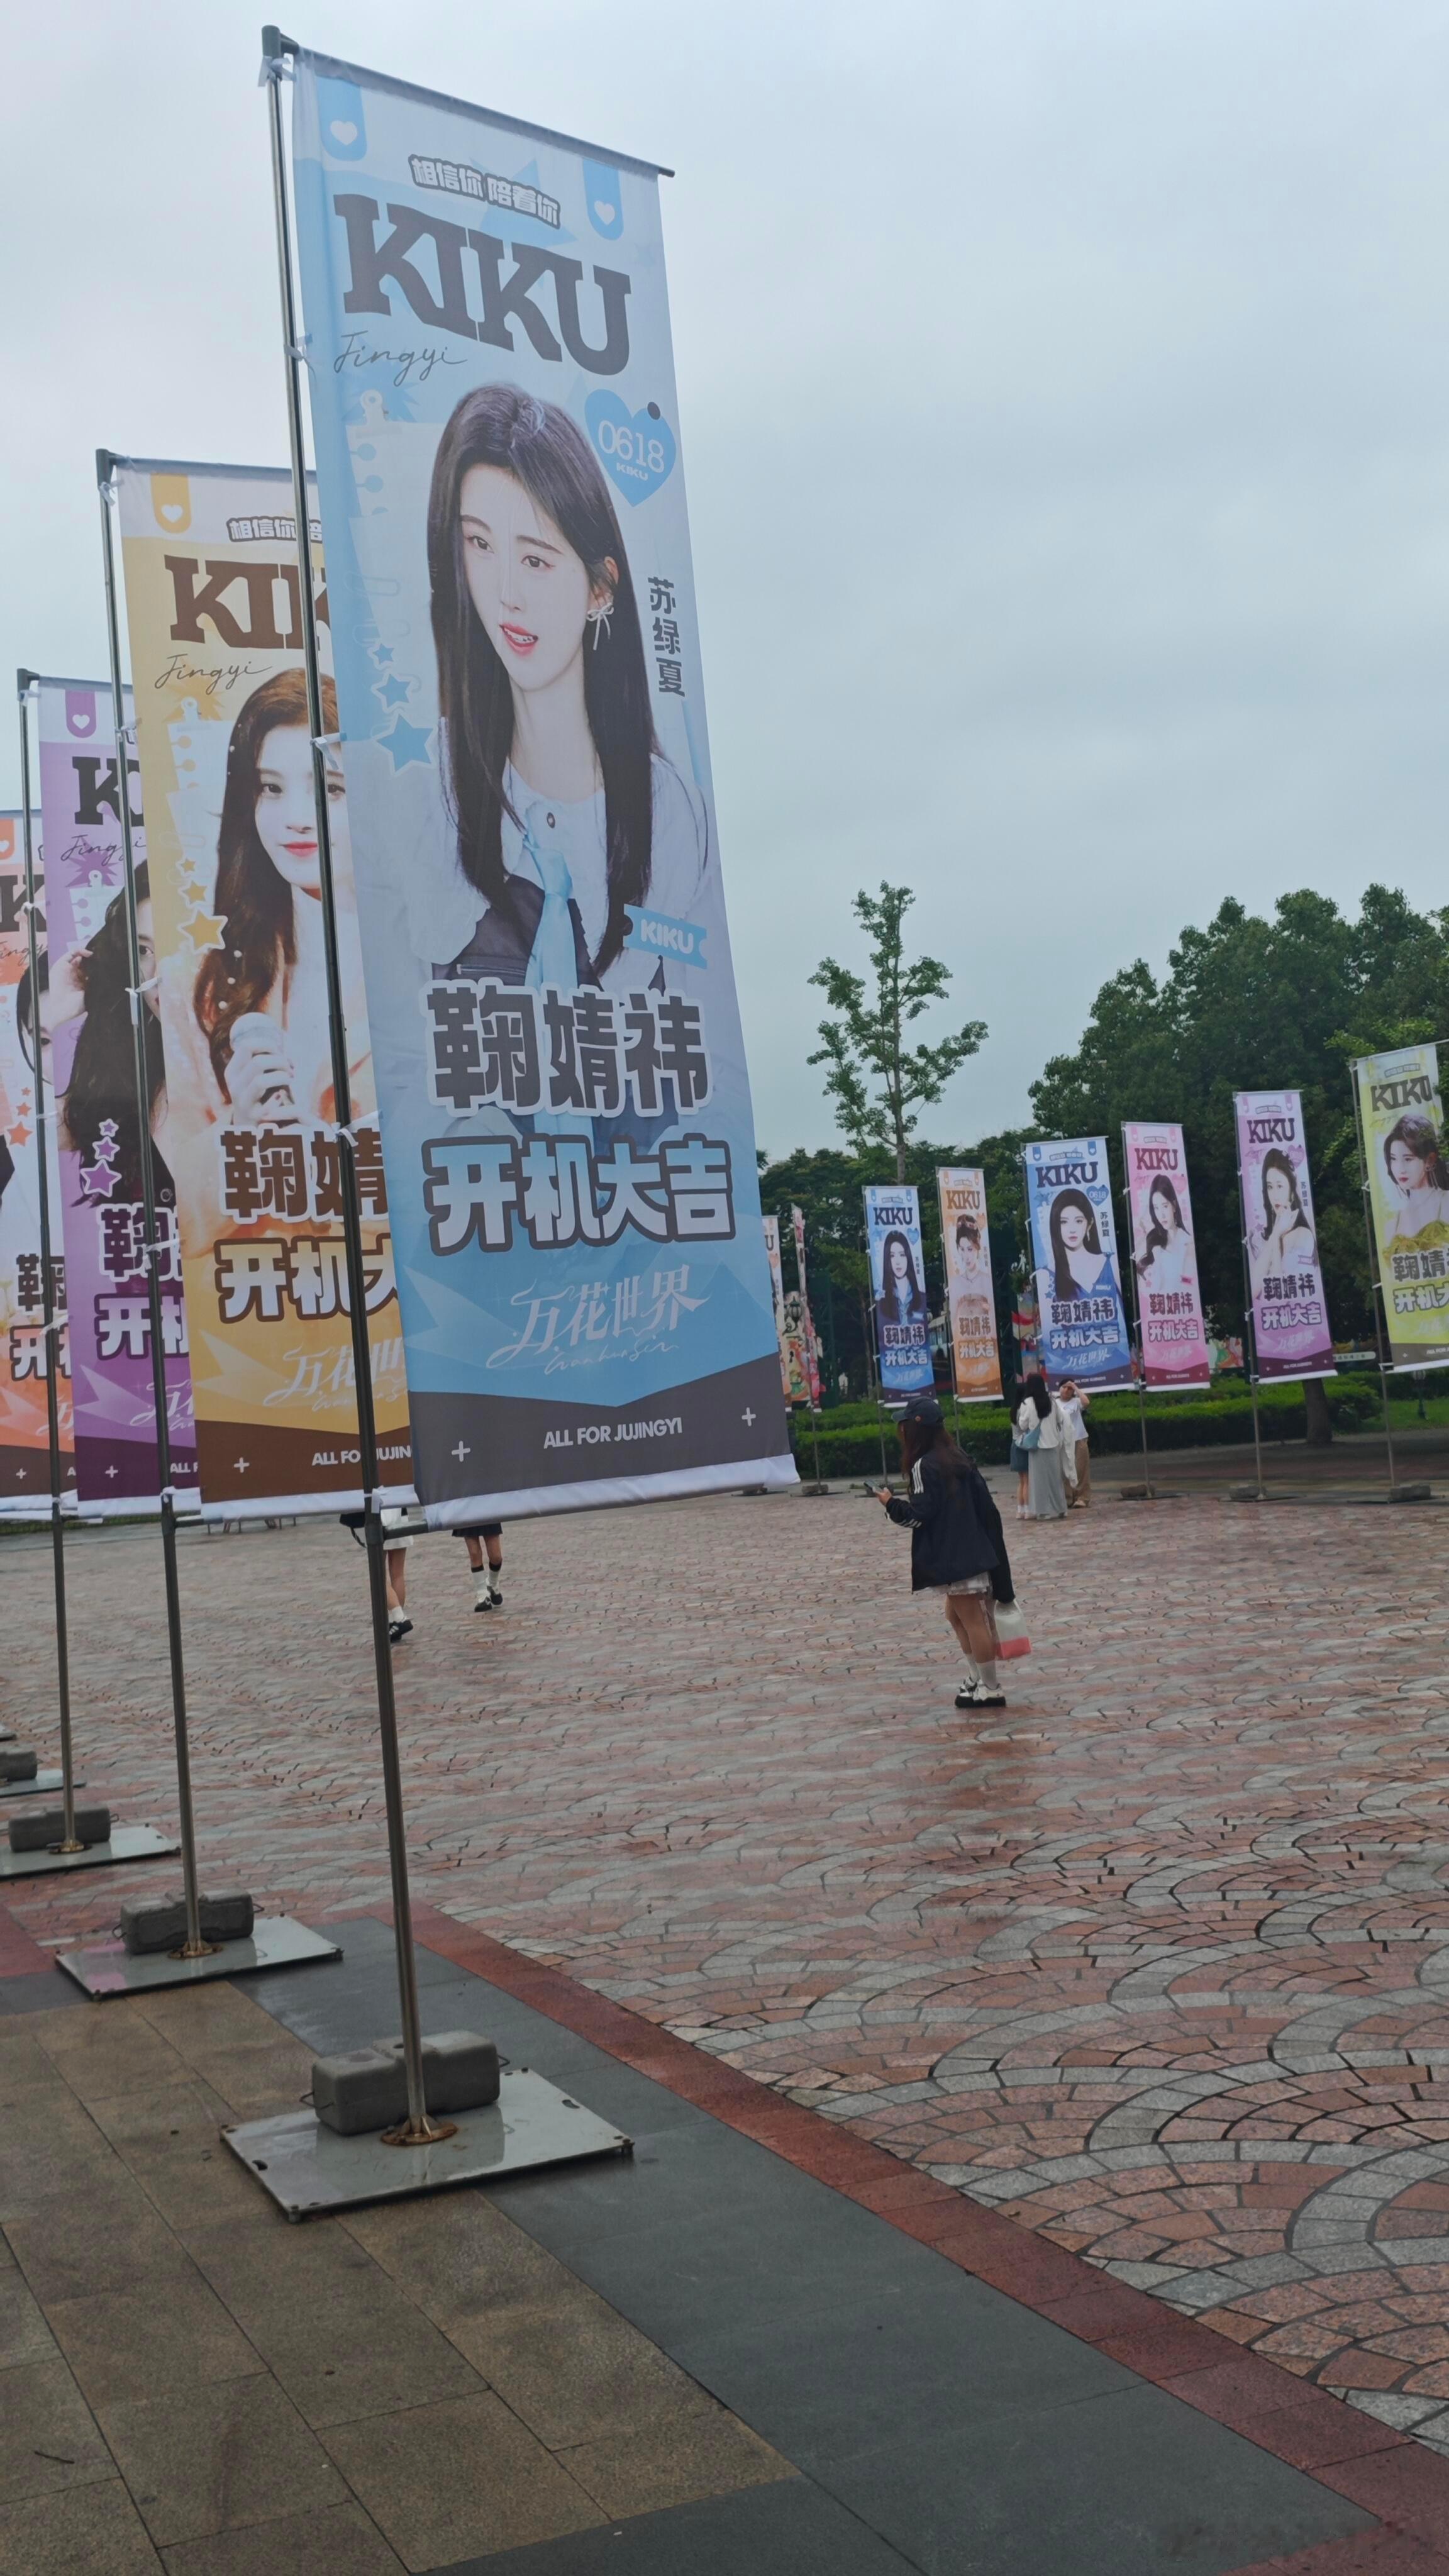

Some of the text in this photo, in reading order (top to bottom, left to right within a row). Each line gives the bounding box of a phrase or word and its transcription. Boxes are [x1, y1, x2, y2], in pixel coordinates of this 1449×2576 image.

[409, 155, 560, 228] 相信你 陪着你
[333, 194, 631, 375] KIKU
[333, 330, 468, 387] Jingyi
[598, 419, 664, 473] 0618
[648, 576, 686, 697] 苏绿夏
[60, 834, 146, 867] Jingi
[641, 919, 693, 954] KIKU
[426, 984, 708, 1111] 鞠婧祎
[1246, 1118, 1295, 1143] KIKU
[1135, 1148, 1179, 1170] KIKU
[1035, 1161, 1099, 1188] KIKU
[426, 1135, 734, 1253] 开机大吉
[946, 1190, 980, 1209] KIKU
[873, 1207, 913, 1225] KIKU
[1392, 1249, 1449, 1282] 鞠婧
[1051, 1298, 1114, 1325] 鞠婧祎
[1262, 1302, 1322, 1330] 开机大吉
[1051, 1325, 1119, 1350] 开机大吉
[1148, 1319, 1199, 1342] 开机大吉
[886, 1348, 928, 1366] 开机大吉
[543, 1417, 682, 1449] ALL FOR JUJINGYI
[170, 1462, 191, 1474] ALL
[311, 1452, 338, 1466] ALL
[340, 1449, 361, 1464] FO
